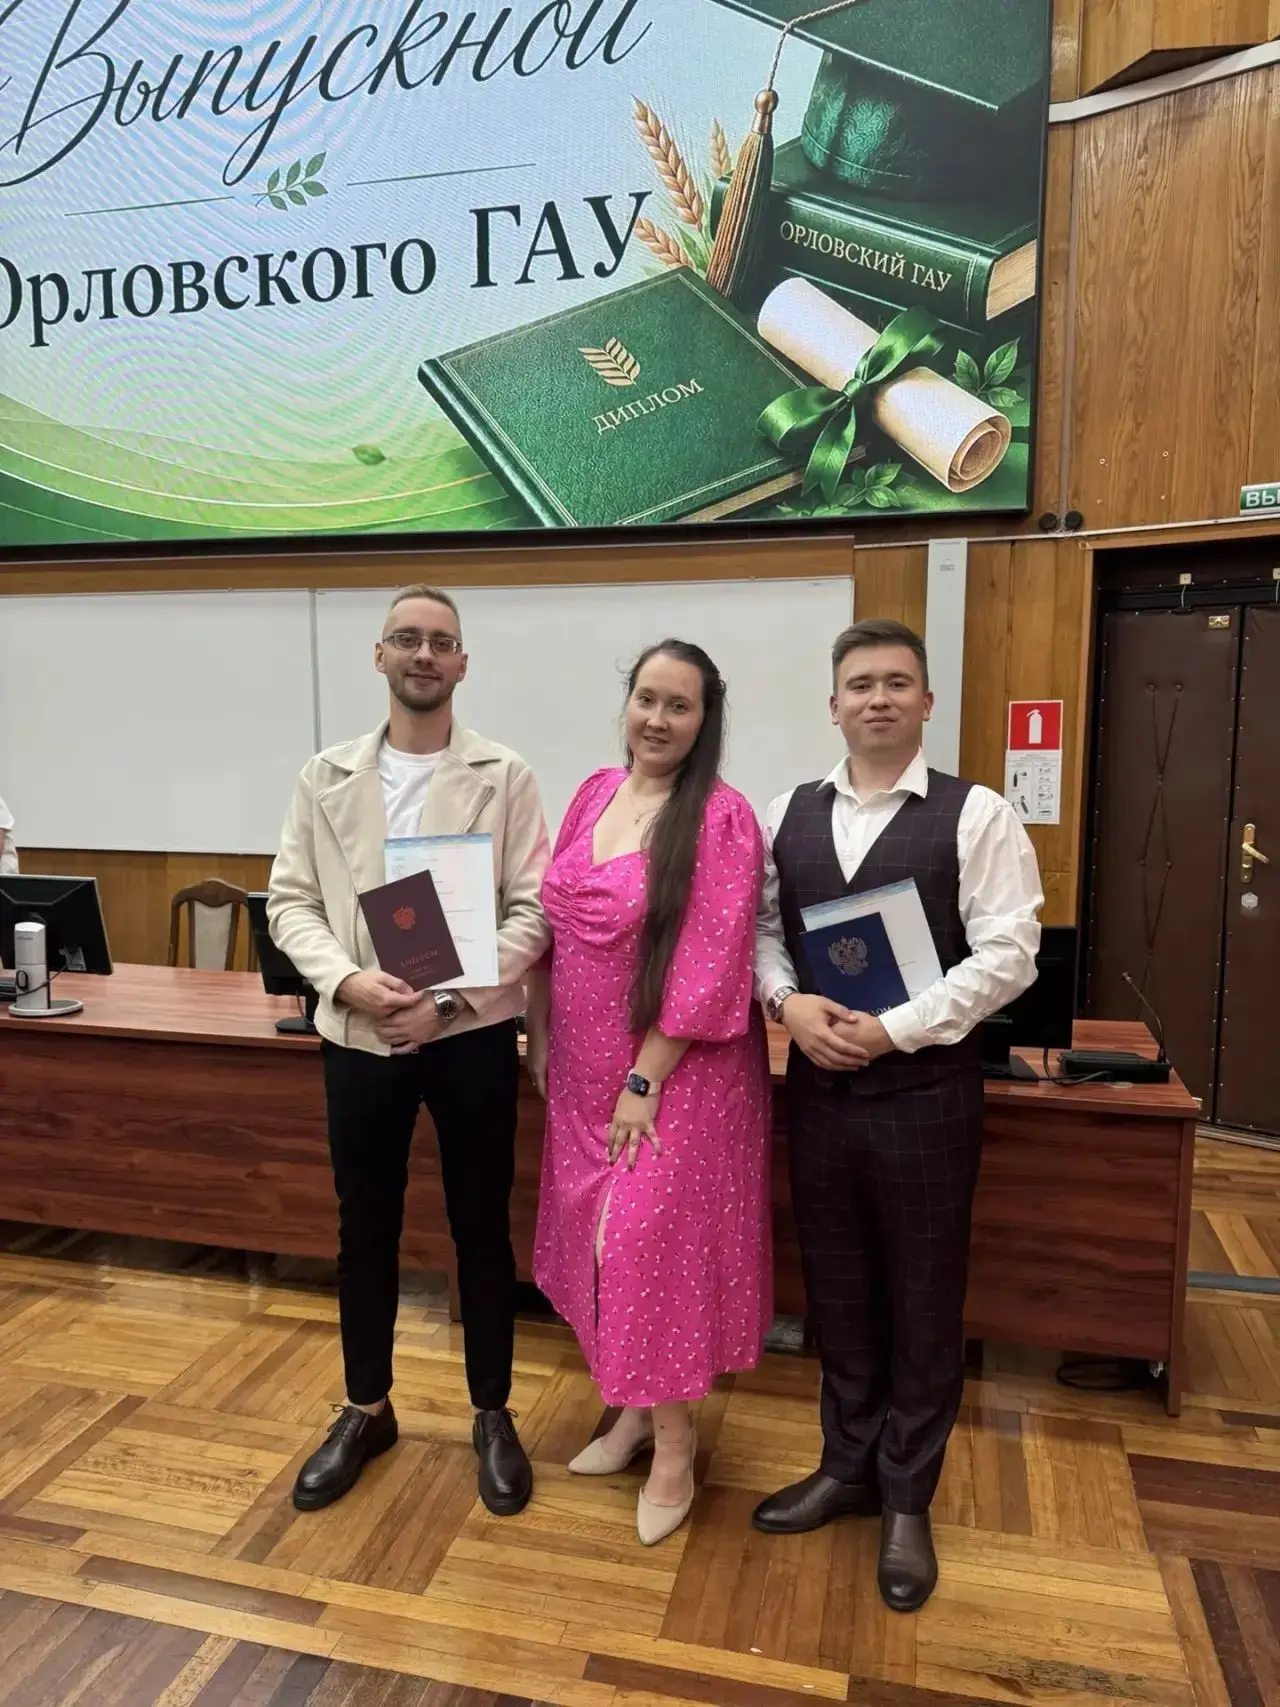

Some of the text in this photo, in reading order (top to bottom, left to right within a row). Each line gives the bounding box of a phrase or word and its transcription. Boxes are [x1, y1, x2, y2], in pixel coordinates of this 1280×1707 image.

[471, 192, 652, 289] ГАУ
[780, 220, 952, 292] ОРЛОВСКИЙ ГАУ
[592, 378, 705, 435] ДИПЛОМ
